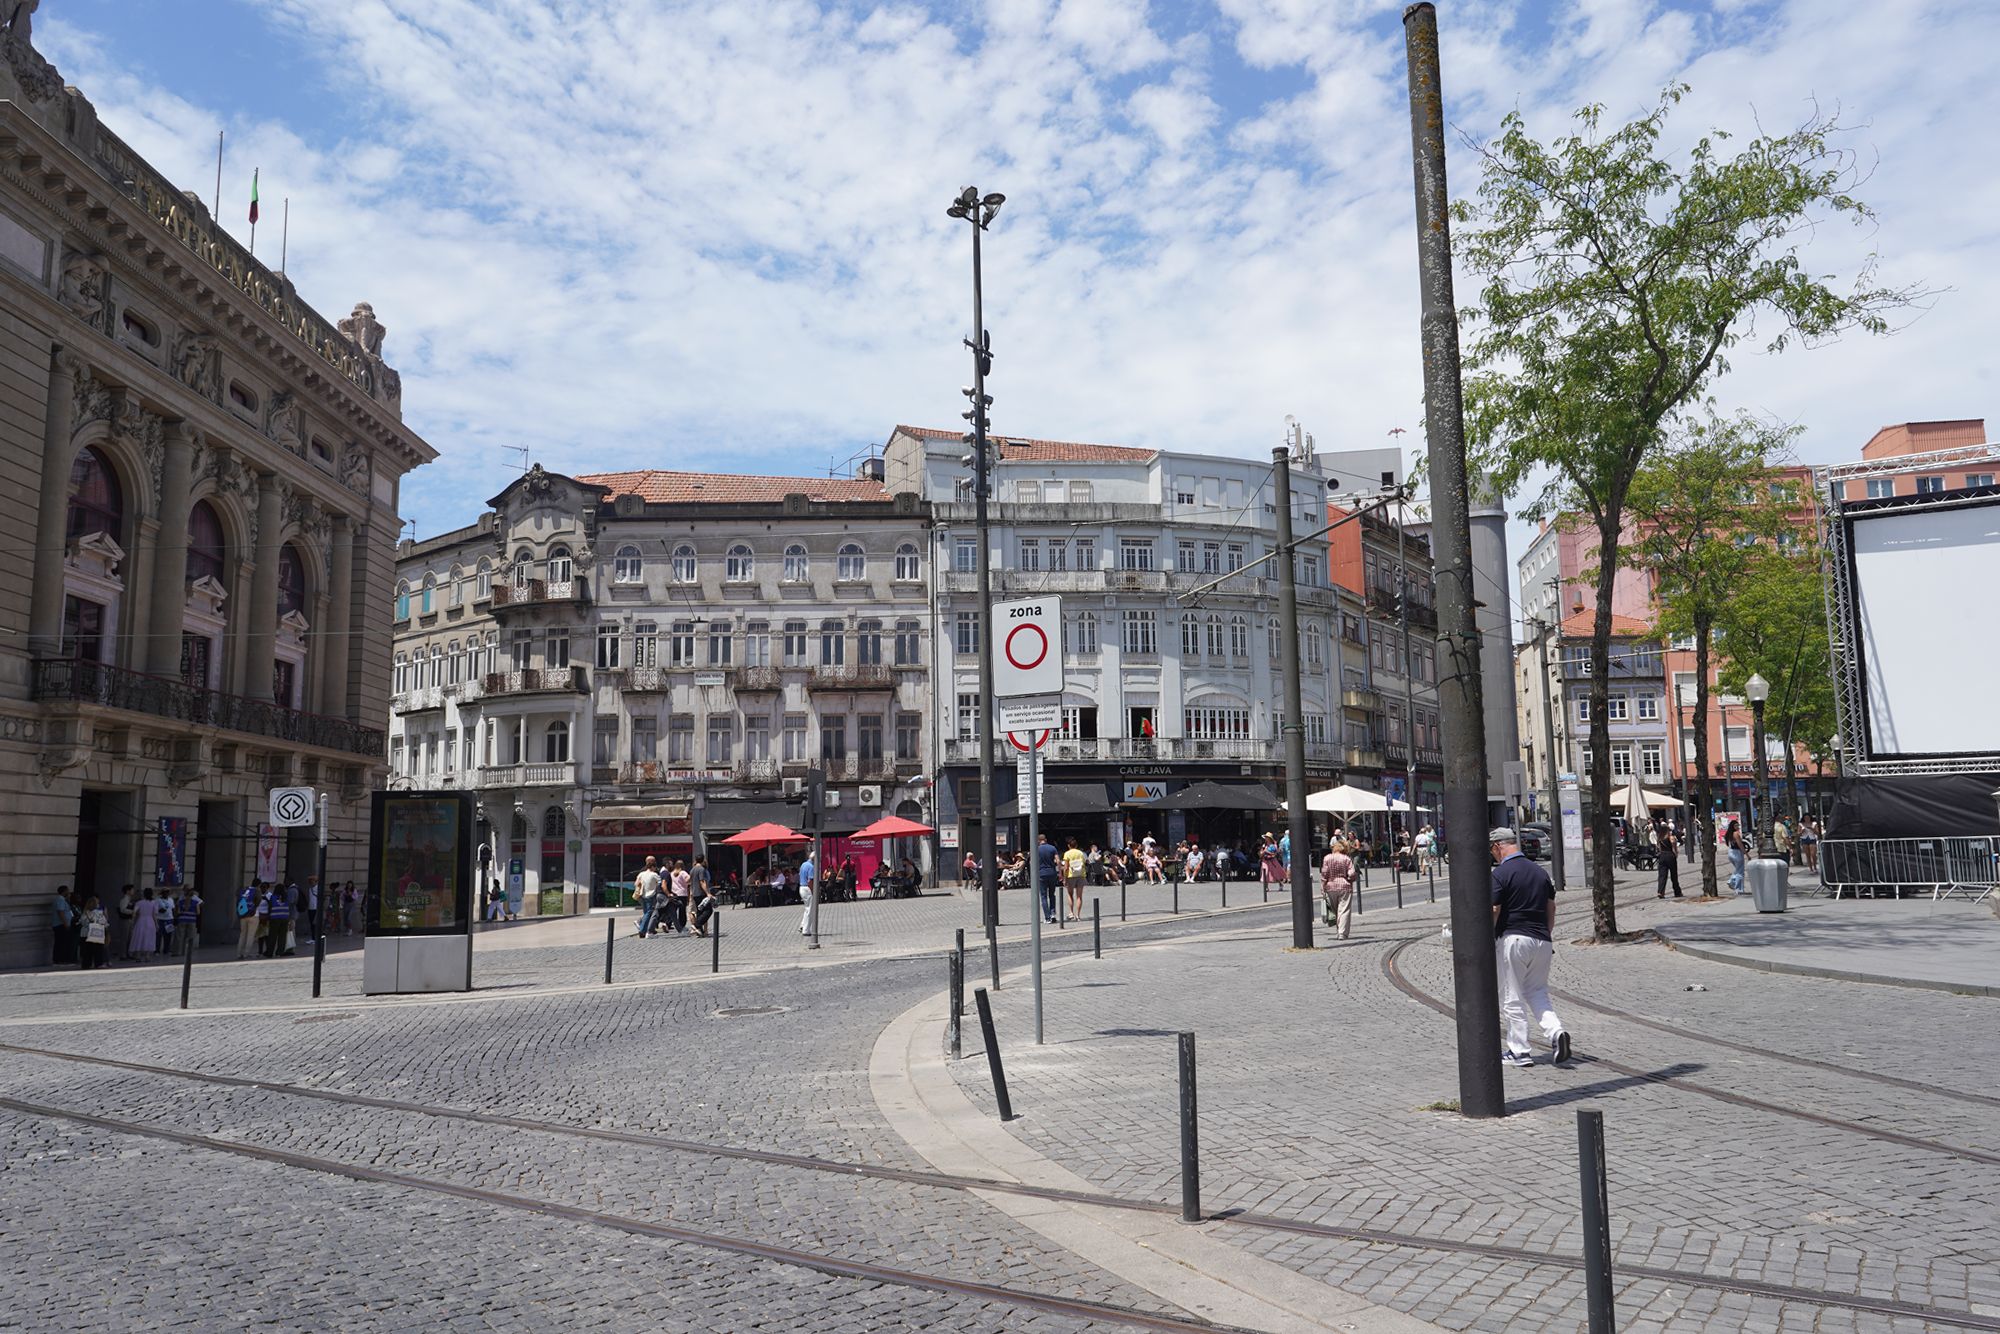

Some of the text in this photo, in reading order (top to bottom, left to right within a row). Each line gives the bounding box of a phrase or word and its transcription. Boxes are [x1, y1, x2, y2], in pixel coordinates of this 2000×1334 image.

[1010, 606, 1042, 618] zona
[1148, 766, 1173, 775] JAVA
[1128, 784, 1163, 798] JAVA
